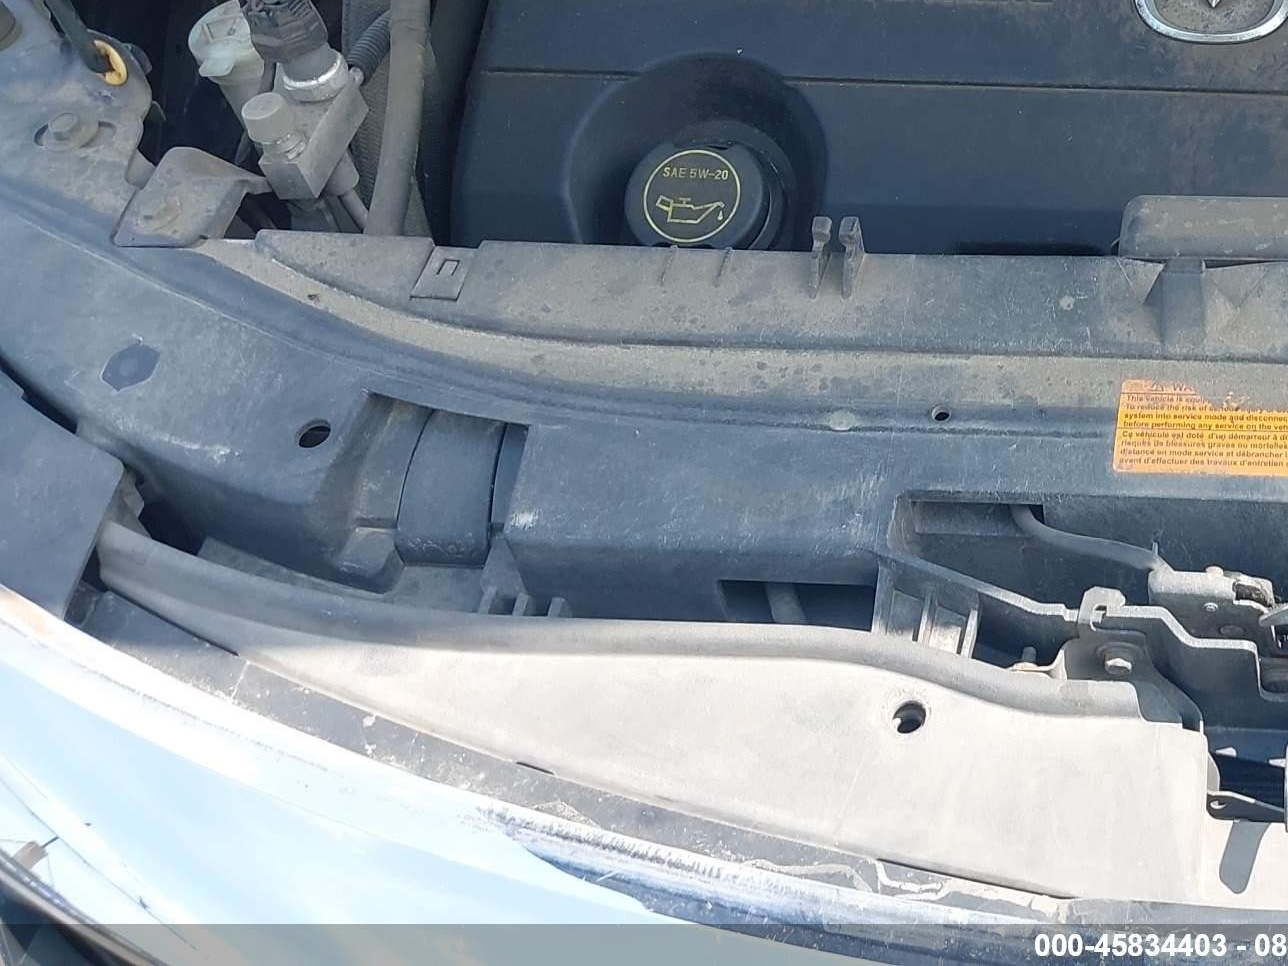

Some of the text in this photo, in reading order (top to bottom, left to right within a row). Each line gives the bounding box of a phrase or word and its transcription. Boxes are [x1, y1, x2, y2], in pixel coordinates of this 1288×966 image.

[663, 167, 729, 180] SAE 5W-20
[1145, 395, 1174, 403] vehicle
[1176, 395, 1184, 403] is
[1137, 403, 1165, 411] reduce
[1167, 403, 1180, 411] the
[1182, 404, 1197, 412] risk
[1199, 404, 1208, 412] of
[1229, 414, 1245, 422] and
[1151, 421, 1196, 430] performing
[1122, 430, 1133, 438] Ce
[1135, 430, 1170, 438] véhicule
[1171, 431, 1184, 439] est
[1186, 431, 1204, 439] doté
[1208, 432, 1226, 440] d'un
[1228, 432, 1271, 441] démarreur
[1120, 440, 1151, 448] risques
[1166, 440, 1206, 448] blessures
[1120, 448, 1155, 456] distance
[1236, 450, 1282, 459] débrancher
[1143, 457, 1188, 465] d'effectuer
[1190, 458, 1205, 466] des
[1206, 459, 1237, 467] travaux
[1239, 459, 1284, 467] d'entretien
